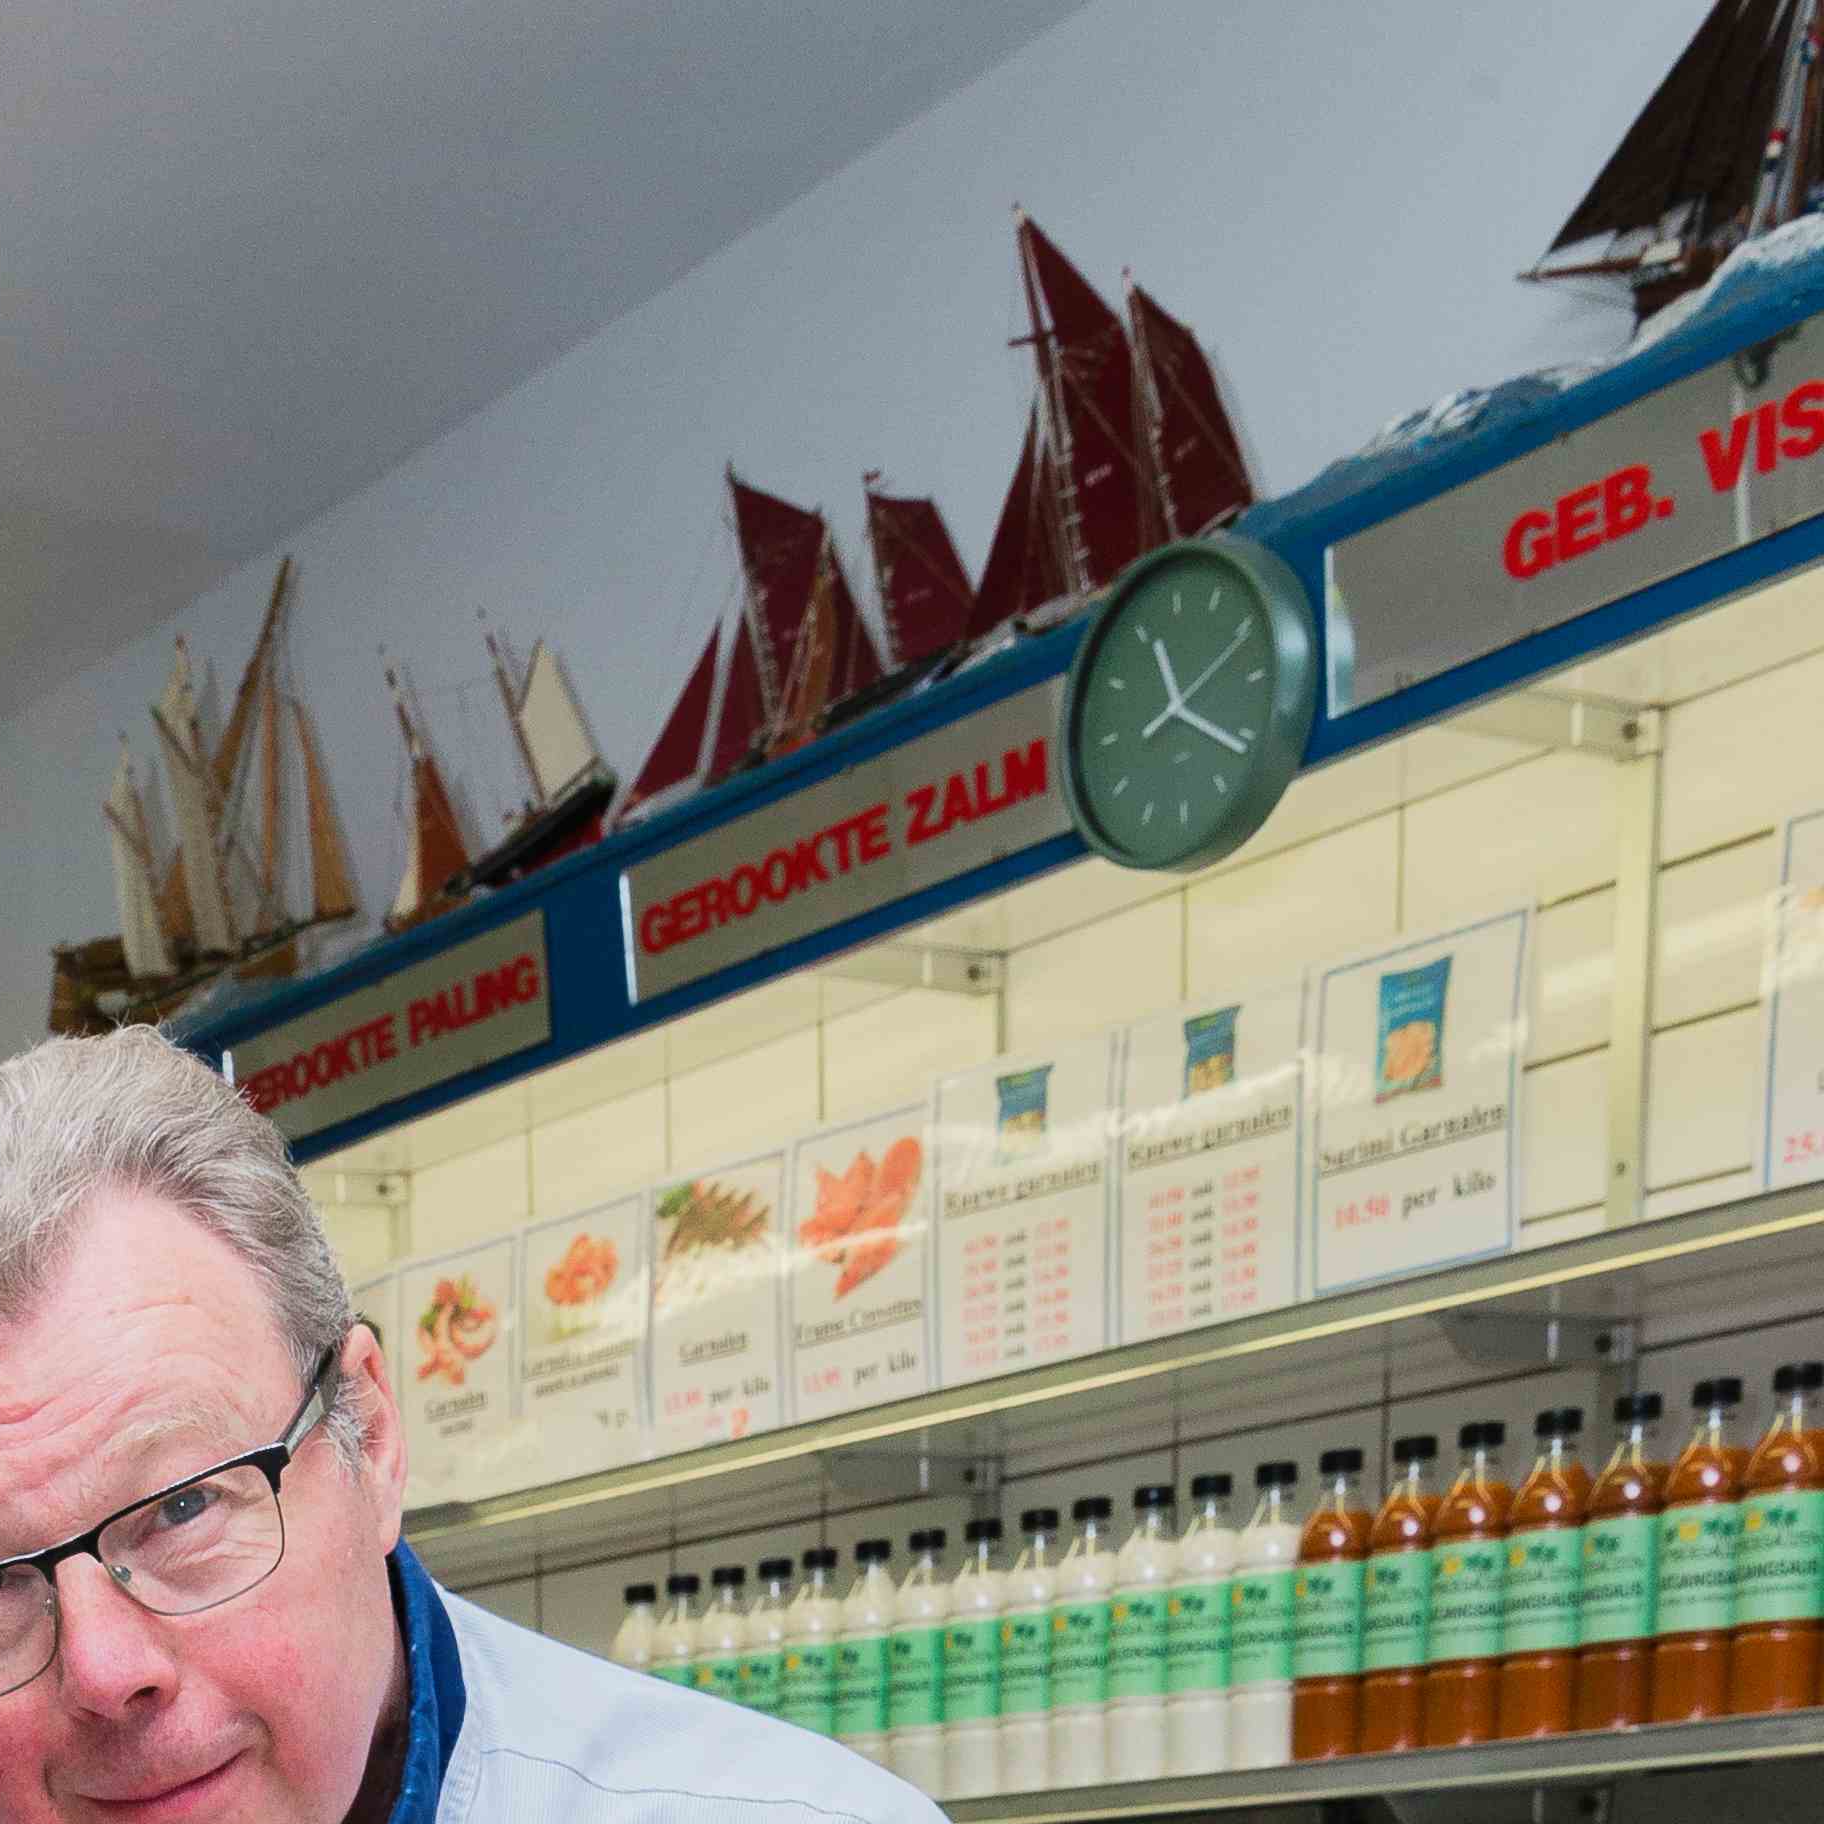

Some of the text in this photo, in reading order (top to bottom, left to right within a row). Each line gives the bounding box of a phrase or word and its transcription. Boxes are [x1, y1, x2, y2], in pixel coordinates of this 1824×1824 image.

[1501, 379, 1824, 583] GEB. VIS
[639, 736, 1048, 955] GEROOKTE ZALM
[407, 953, 540, 1049] PALING
[1401, 1186, 1437, 1220] per
[1453, 1167, 1498, 1200] kilo
